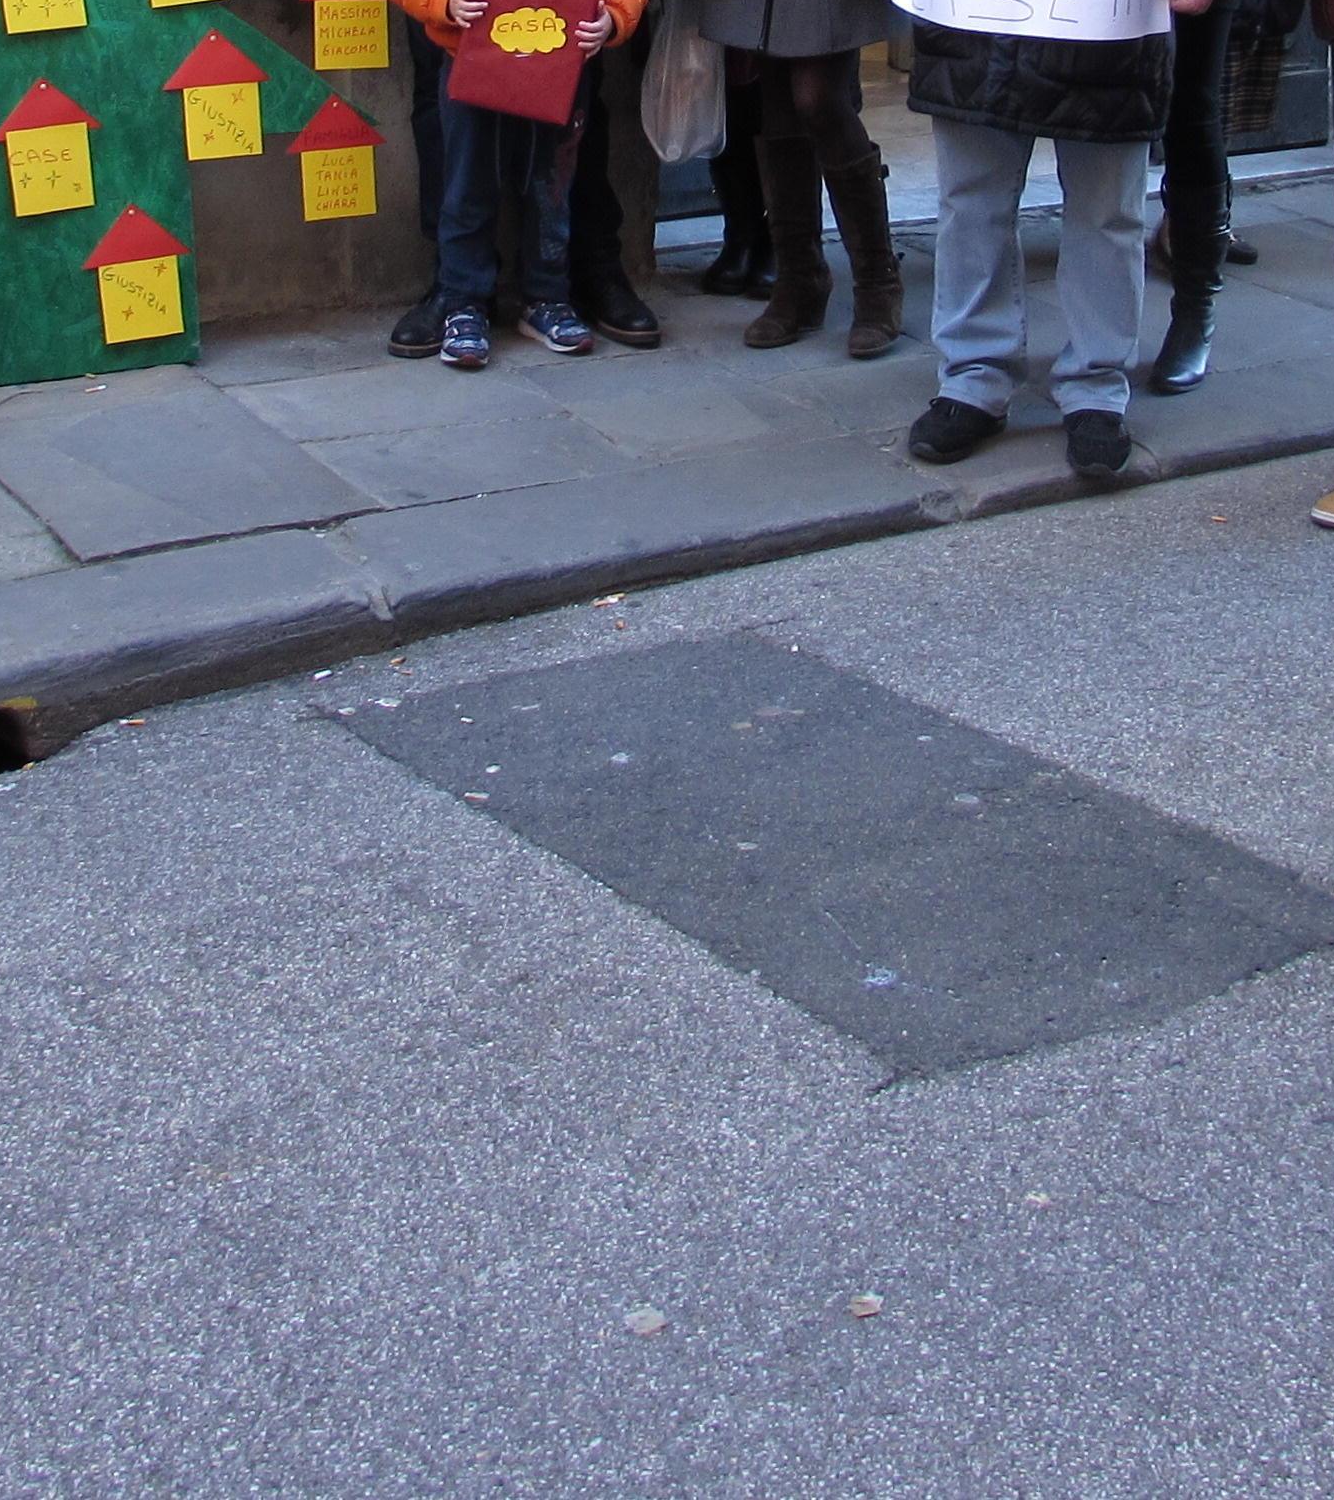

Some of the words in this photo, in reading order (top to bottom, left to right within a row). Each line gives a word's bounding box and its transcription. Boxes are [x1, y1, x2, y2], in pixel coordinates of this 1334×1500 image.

[319, 5, 380, 20] MASSIMO
[319, 26, 376, 38] MICHELA
[496, 16, 557, 34] CASA
[323, 43, 378, 56] GIACOMO
[187, 89, 254, 153] GIUSTIZIA
[10, 148, 72, 165] CASE
[322, 154, 355, 167] LUCA
[316, 168, 359, 181] TANIA
[317, 184, 359, 197] LINDA
[316, 198, 357, 212] CHIARA
[101, 266, 167, 315] GIUSTIZIA
